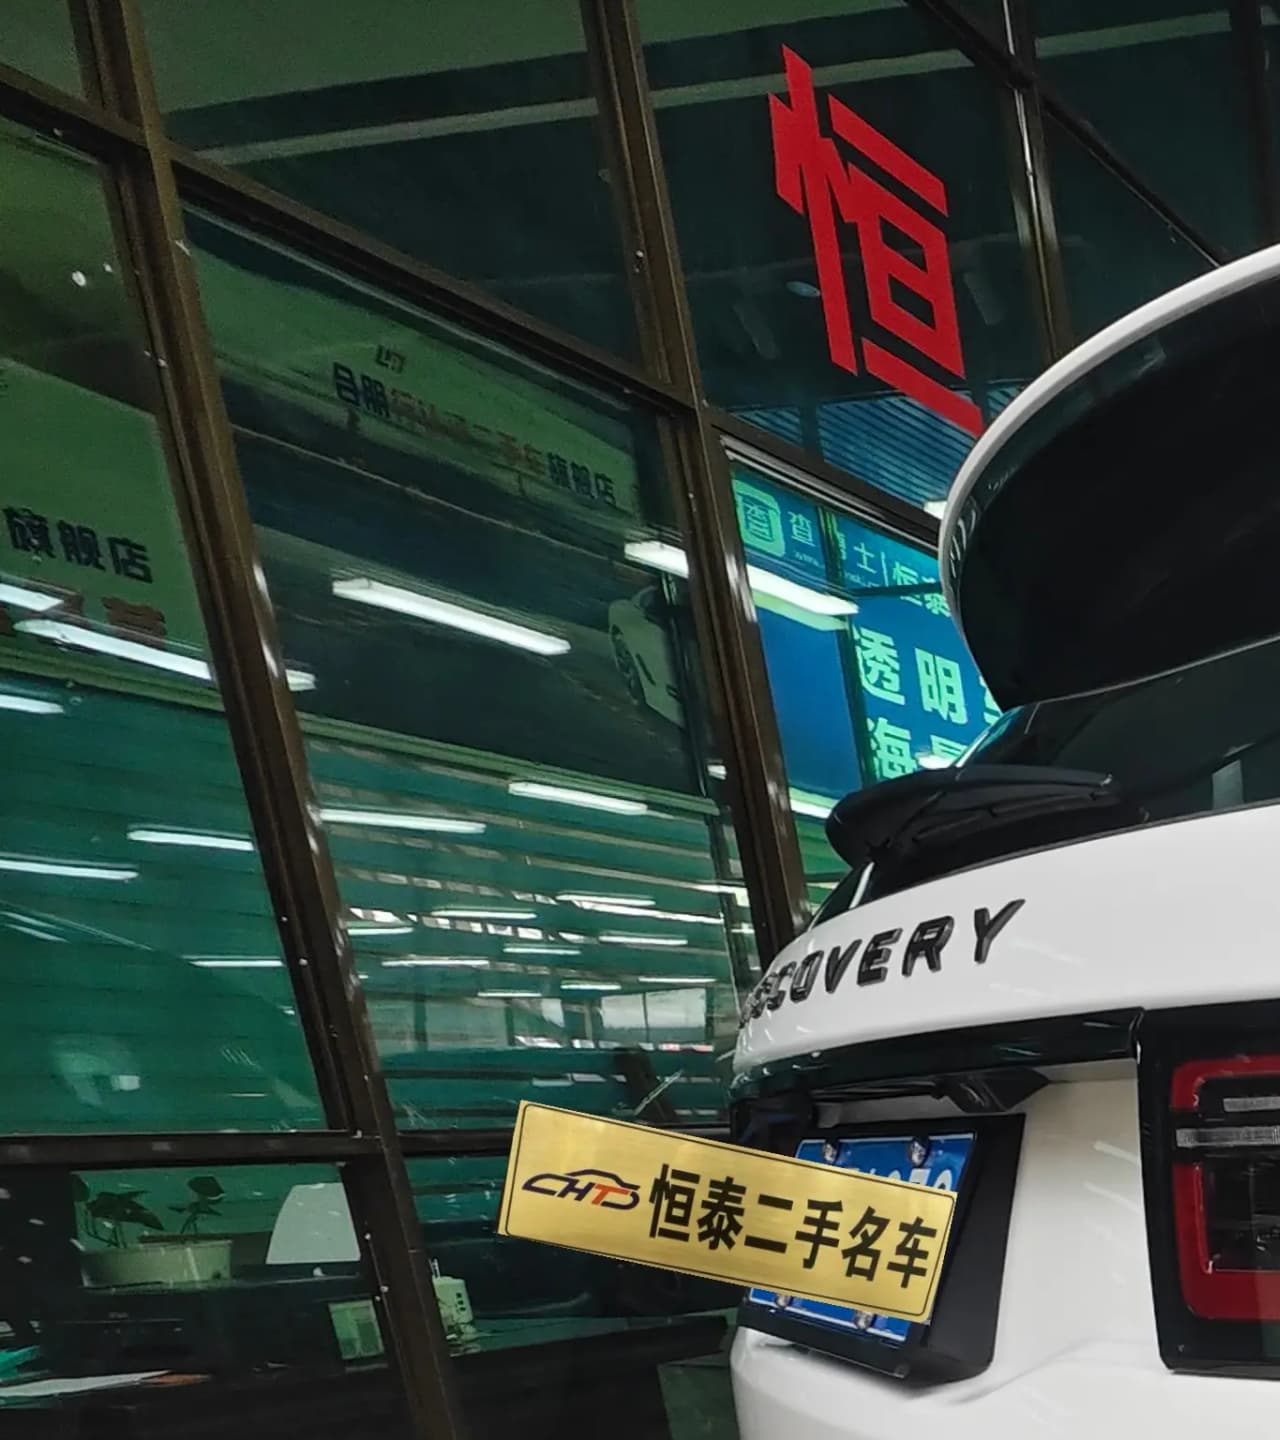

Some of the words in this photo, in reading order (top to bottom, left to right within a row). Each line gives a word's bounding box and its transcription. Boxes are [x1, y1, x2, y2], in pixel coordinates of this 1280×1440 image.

[767, 44, 985, 437] 恒
[2, 506, 153, 584] 旗舰店
